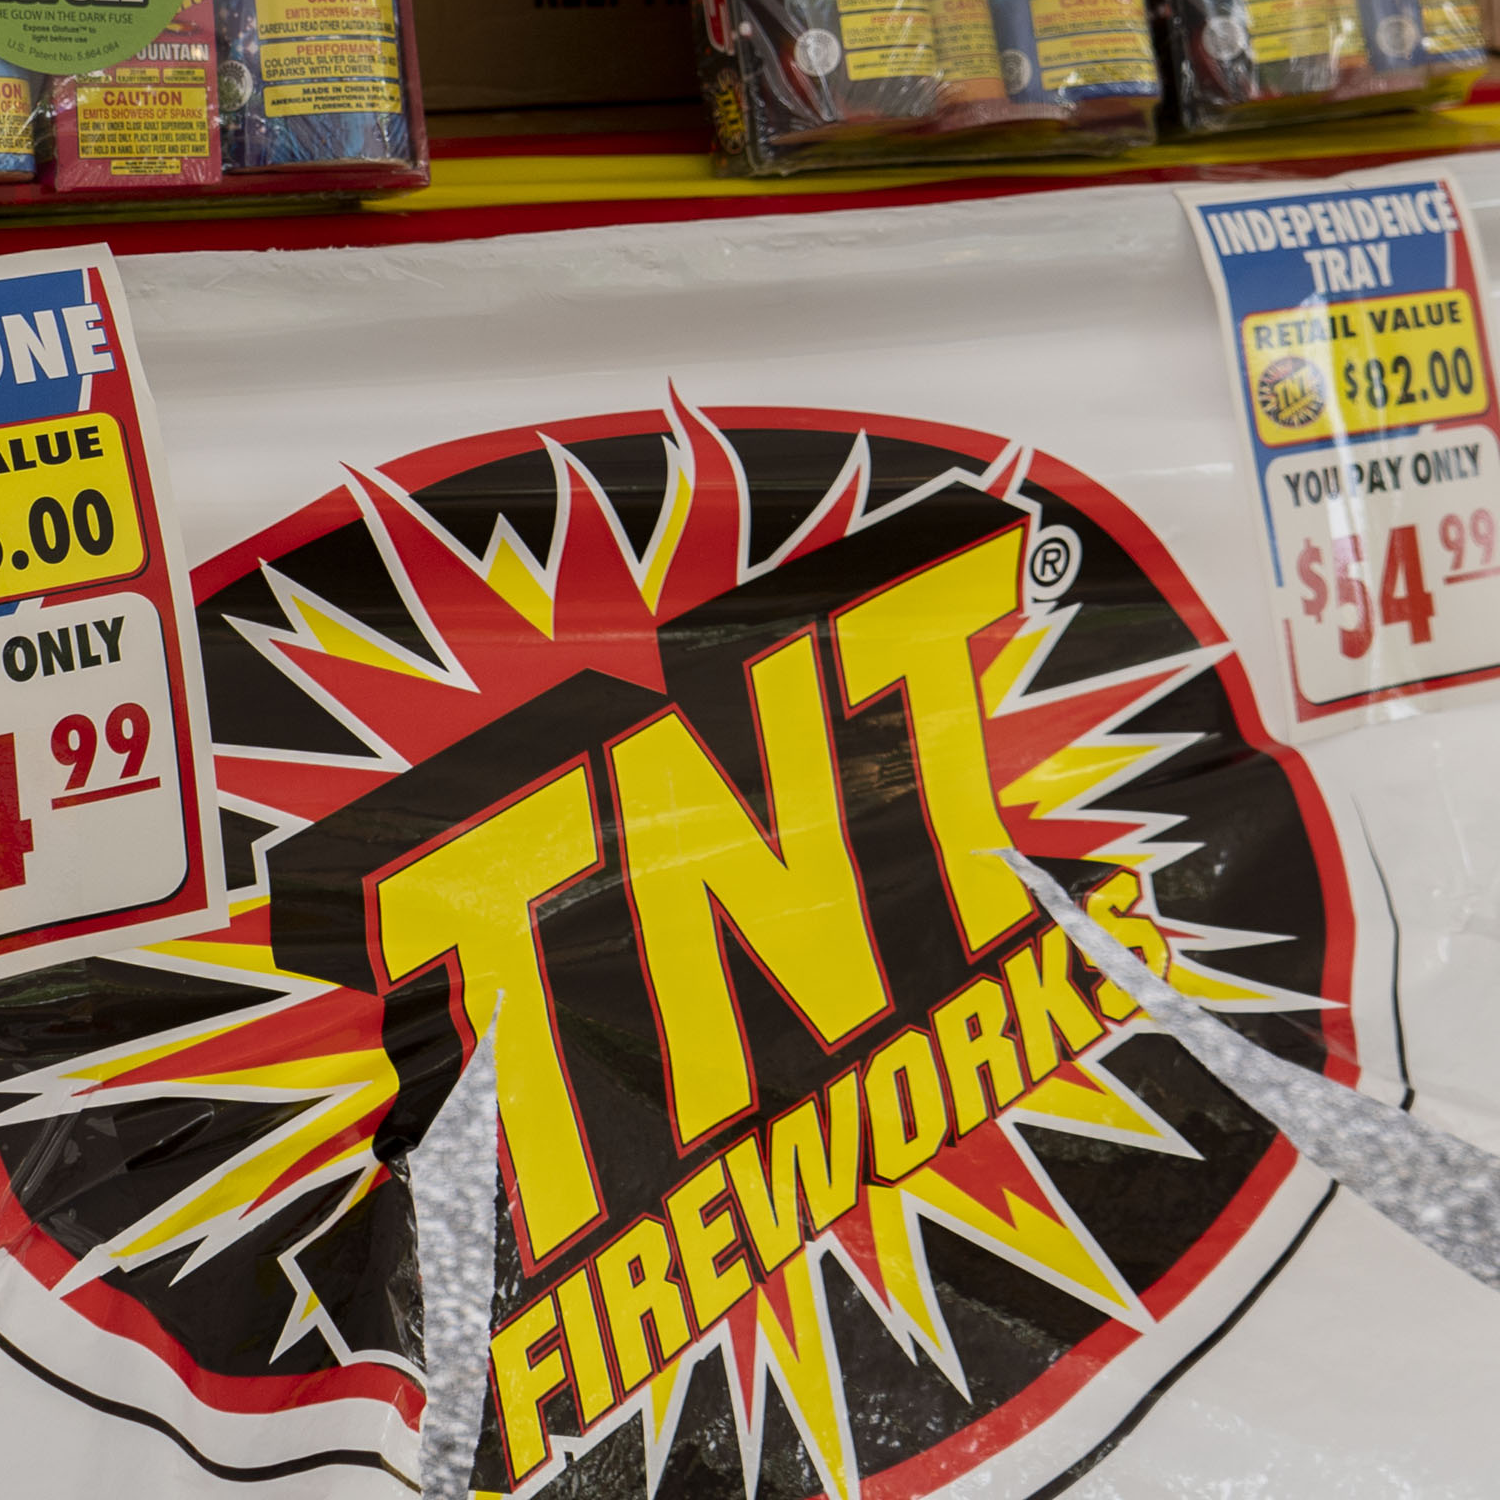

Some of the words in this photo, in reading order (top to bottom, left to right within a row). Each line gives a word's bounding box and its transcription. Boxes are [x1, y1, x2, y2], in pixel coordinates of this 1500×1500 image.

[1206, 186, 1461, 258] INDEPENDENCE
[1304, 241, 1394, 296] TRAY
[1252, 313, 1358, 351] RETAIL
[1370, 300, 1463, 336] VALUE
[1273, 368, 1324, 410] TNT
[1344, 345, 1475, 411] $82.00
[1283, 468, 1341, 509] YOU
[1346, 455, 1404, 495] PAY
[1413, 443, 1483, 486] ONLY
[2, 615, 127, 686] ONLY
[370, 518, 1037, 1270] TNT
